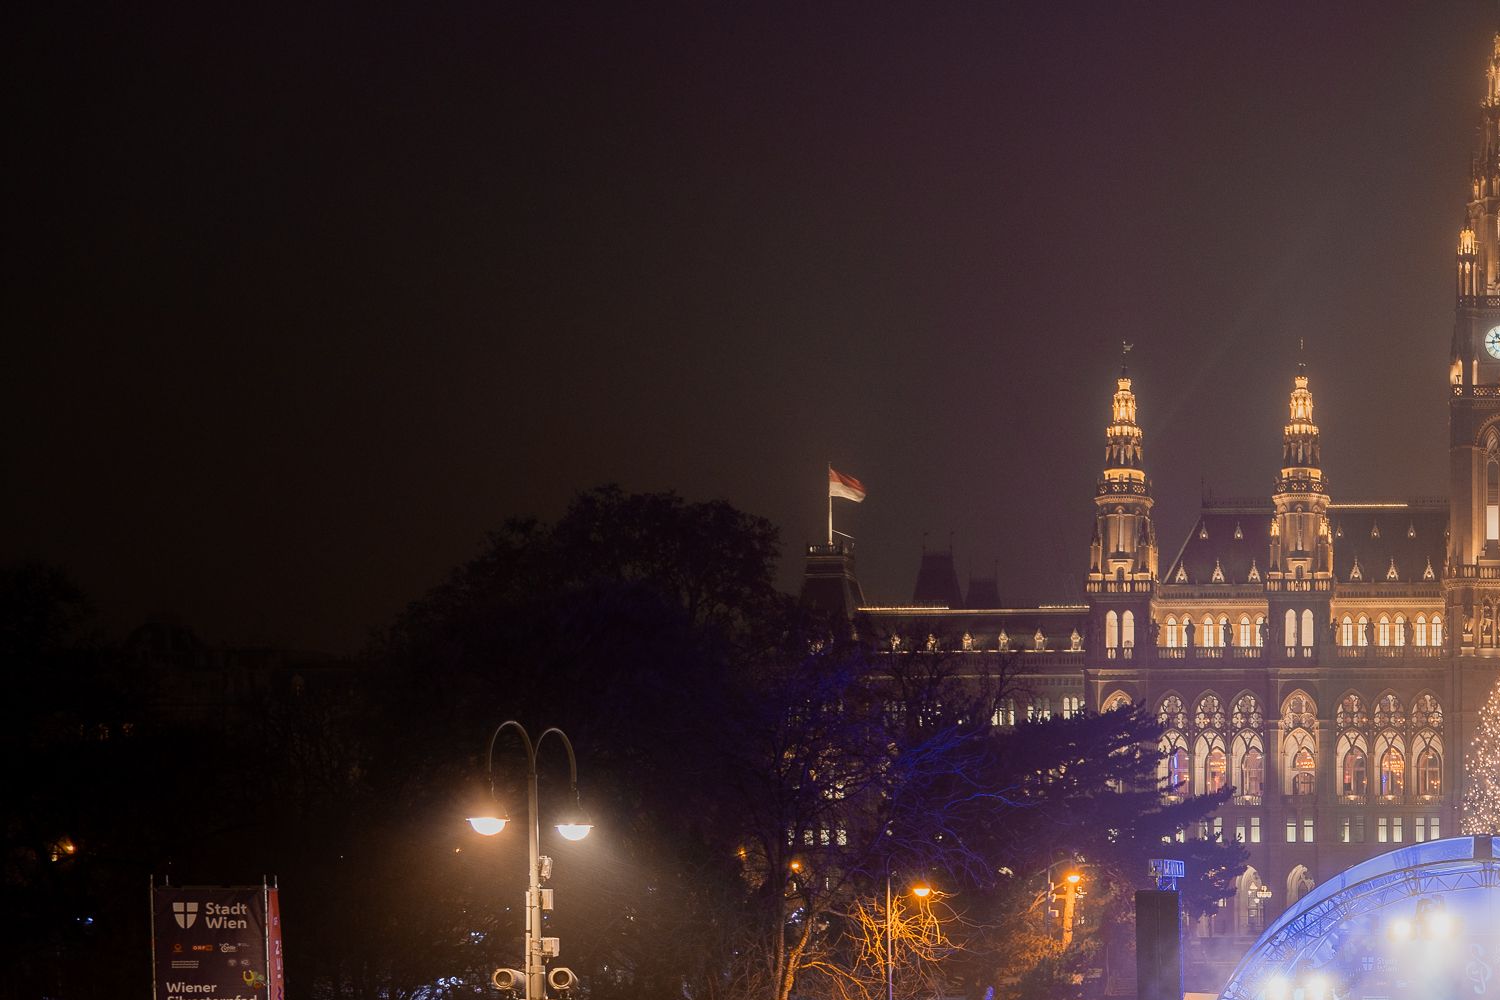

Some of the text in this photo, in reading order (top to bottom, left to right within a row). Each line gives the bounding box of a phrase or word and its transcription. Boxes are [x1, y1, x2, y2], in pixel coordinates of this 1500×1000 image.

[205, 902, 248, 915] Stadt
[205, 916, 248, 929] Wien
[166, 982, 217, 993] Wiener
